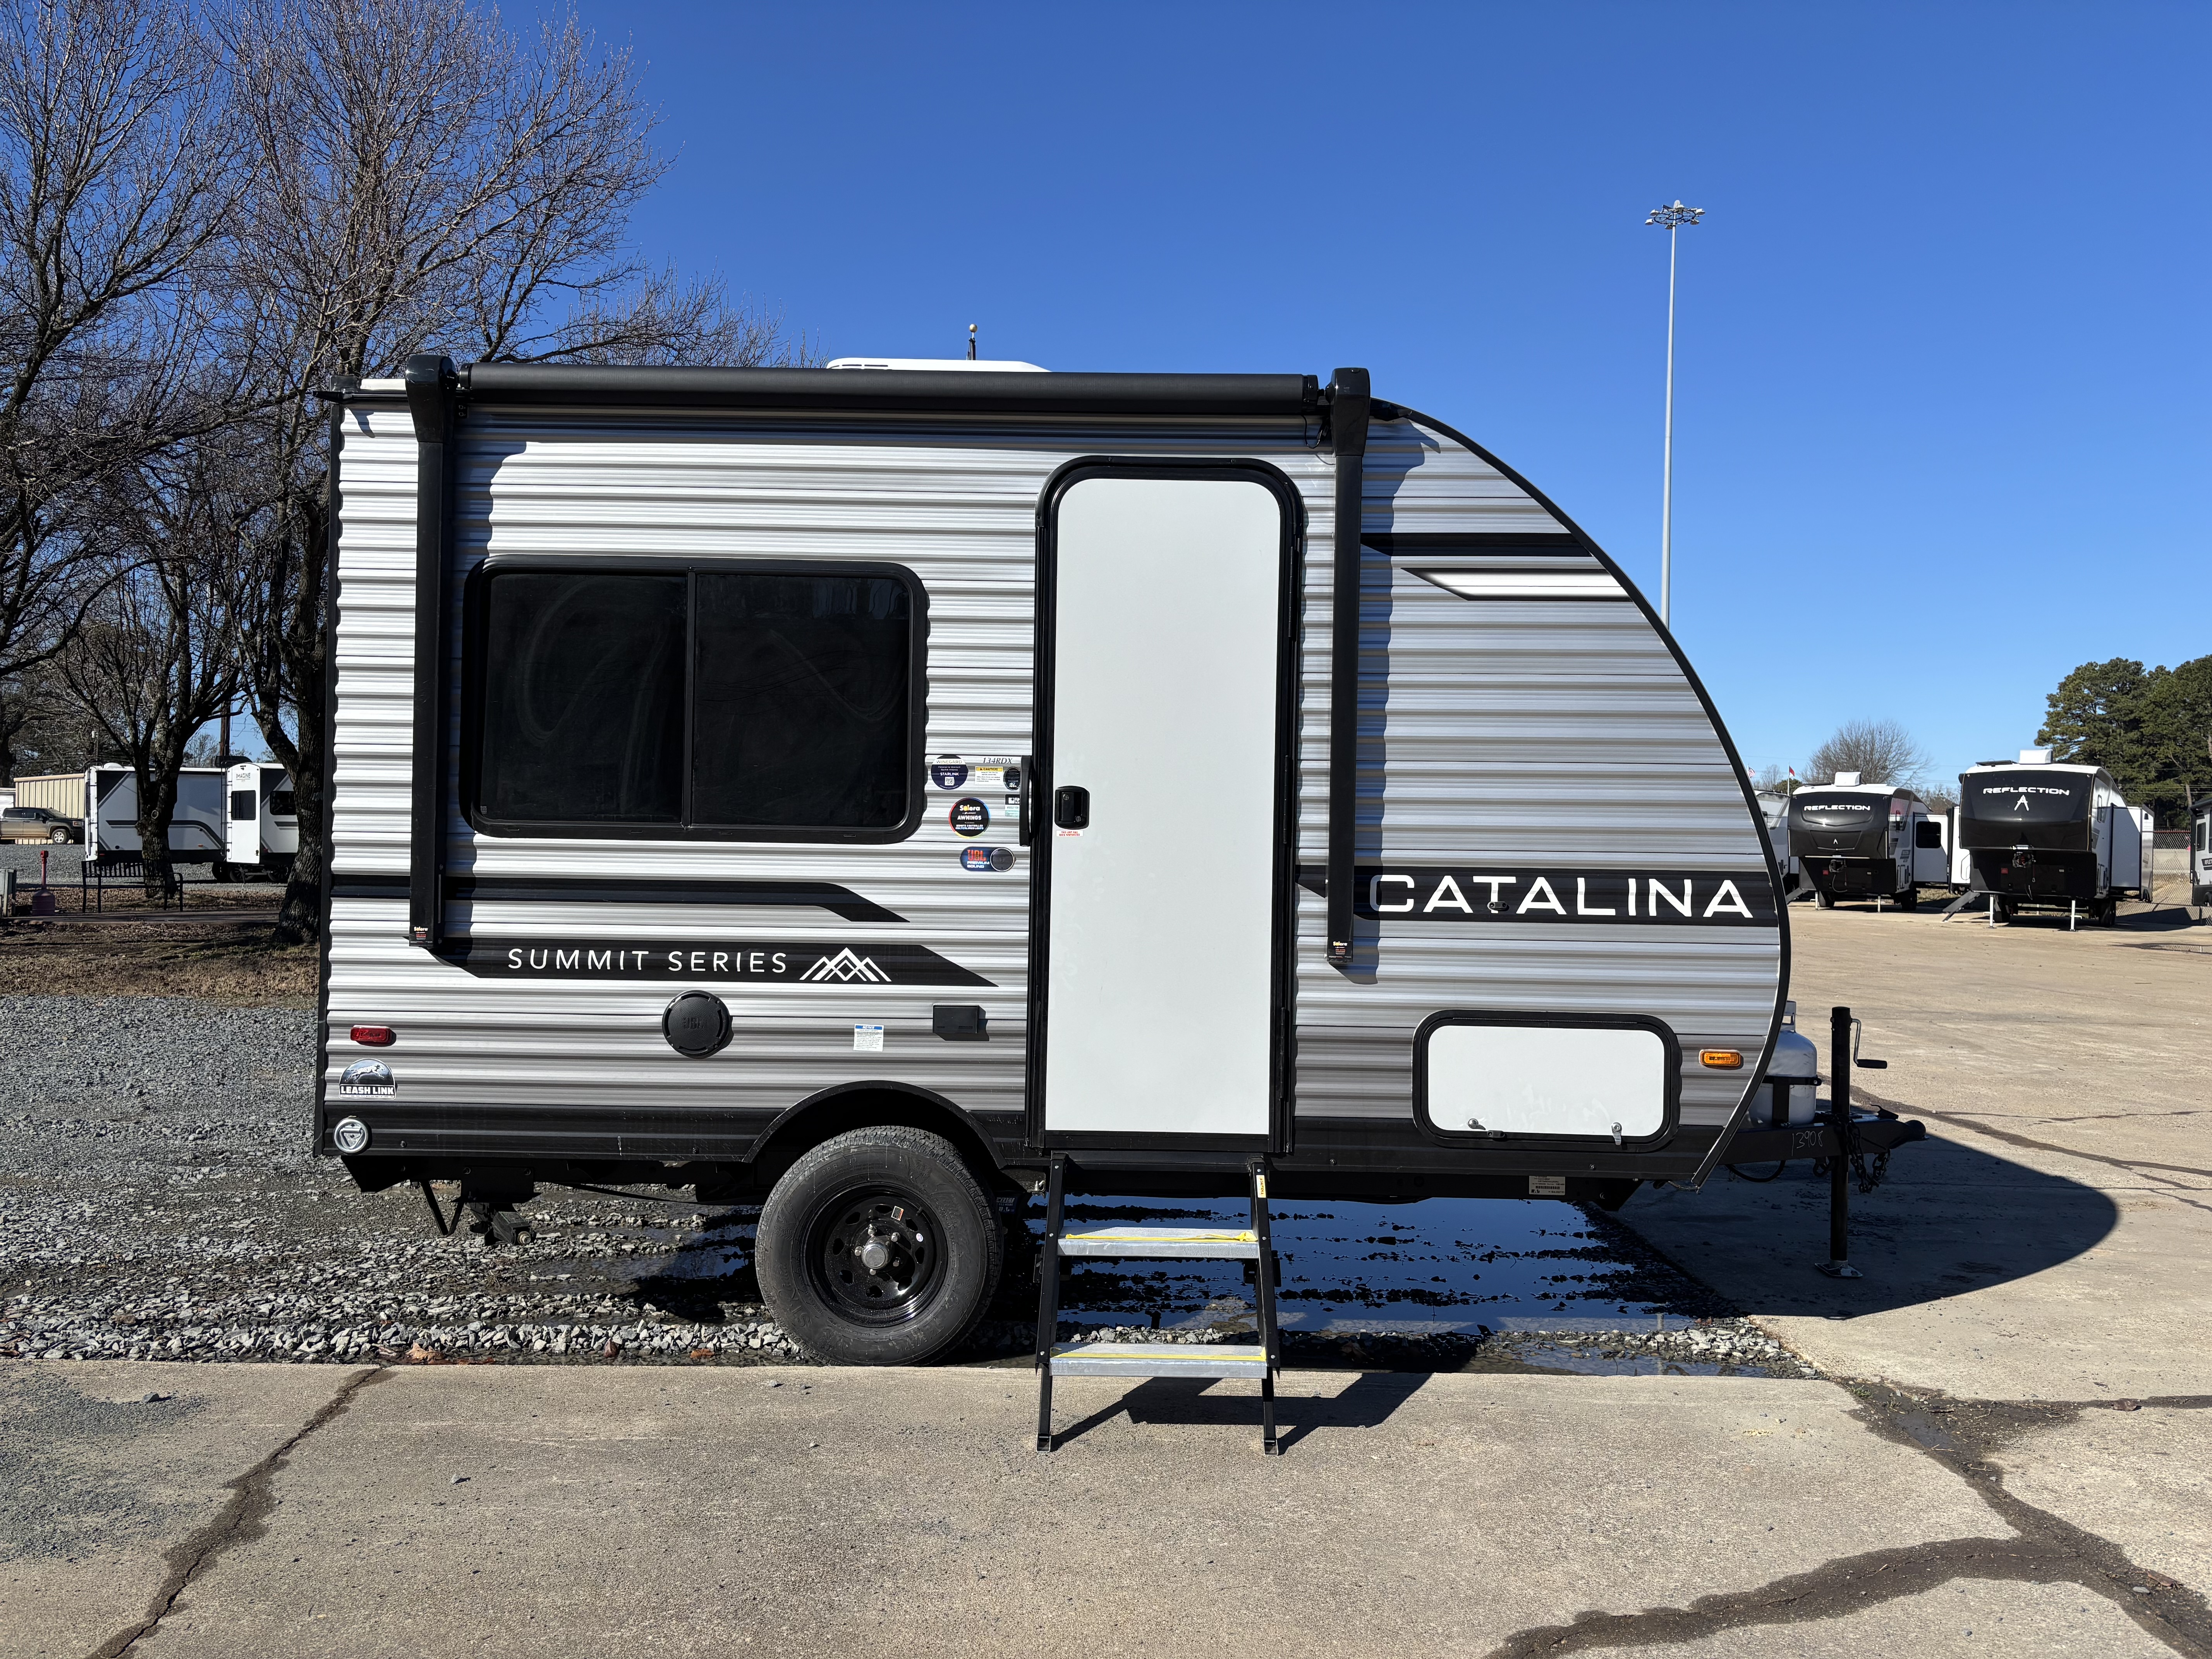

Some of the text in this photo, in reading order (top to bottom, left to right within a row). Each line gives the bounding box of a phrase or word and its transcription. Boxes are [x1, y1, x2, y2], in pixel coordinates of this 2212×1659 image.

[1983, 787, 2069, 796] REFLECTION
[967, 850, 987, 861] JBL
[1370, 875, 1754, 918] CATALINA
[508, 948, 787, 973] SUMMIT SERIES
[341, 1086, 394, 1095] LEASH LINK
[1791, 1130, 1823, 1156] 13908
